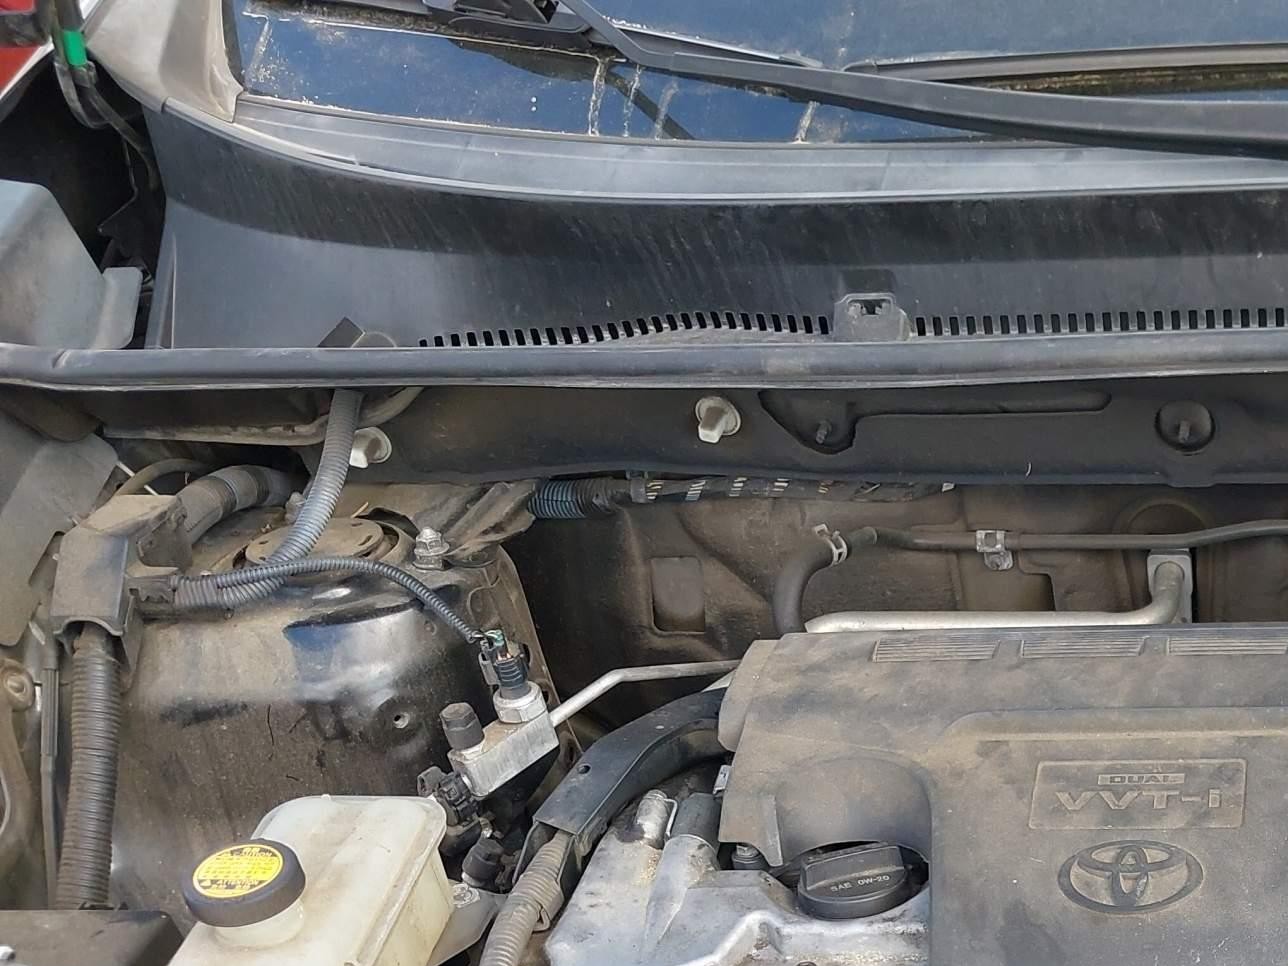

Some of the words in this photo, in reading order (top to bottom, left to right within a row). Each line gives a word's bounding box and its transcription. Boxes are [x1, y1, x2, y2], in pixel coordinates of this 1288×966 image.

[1108, 774, 1170, 784] DUAL
[829, 882, 853, 892] SAE
[857, 874, 891, 887] 0W-20
